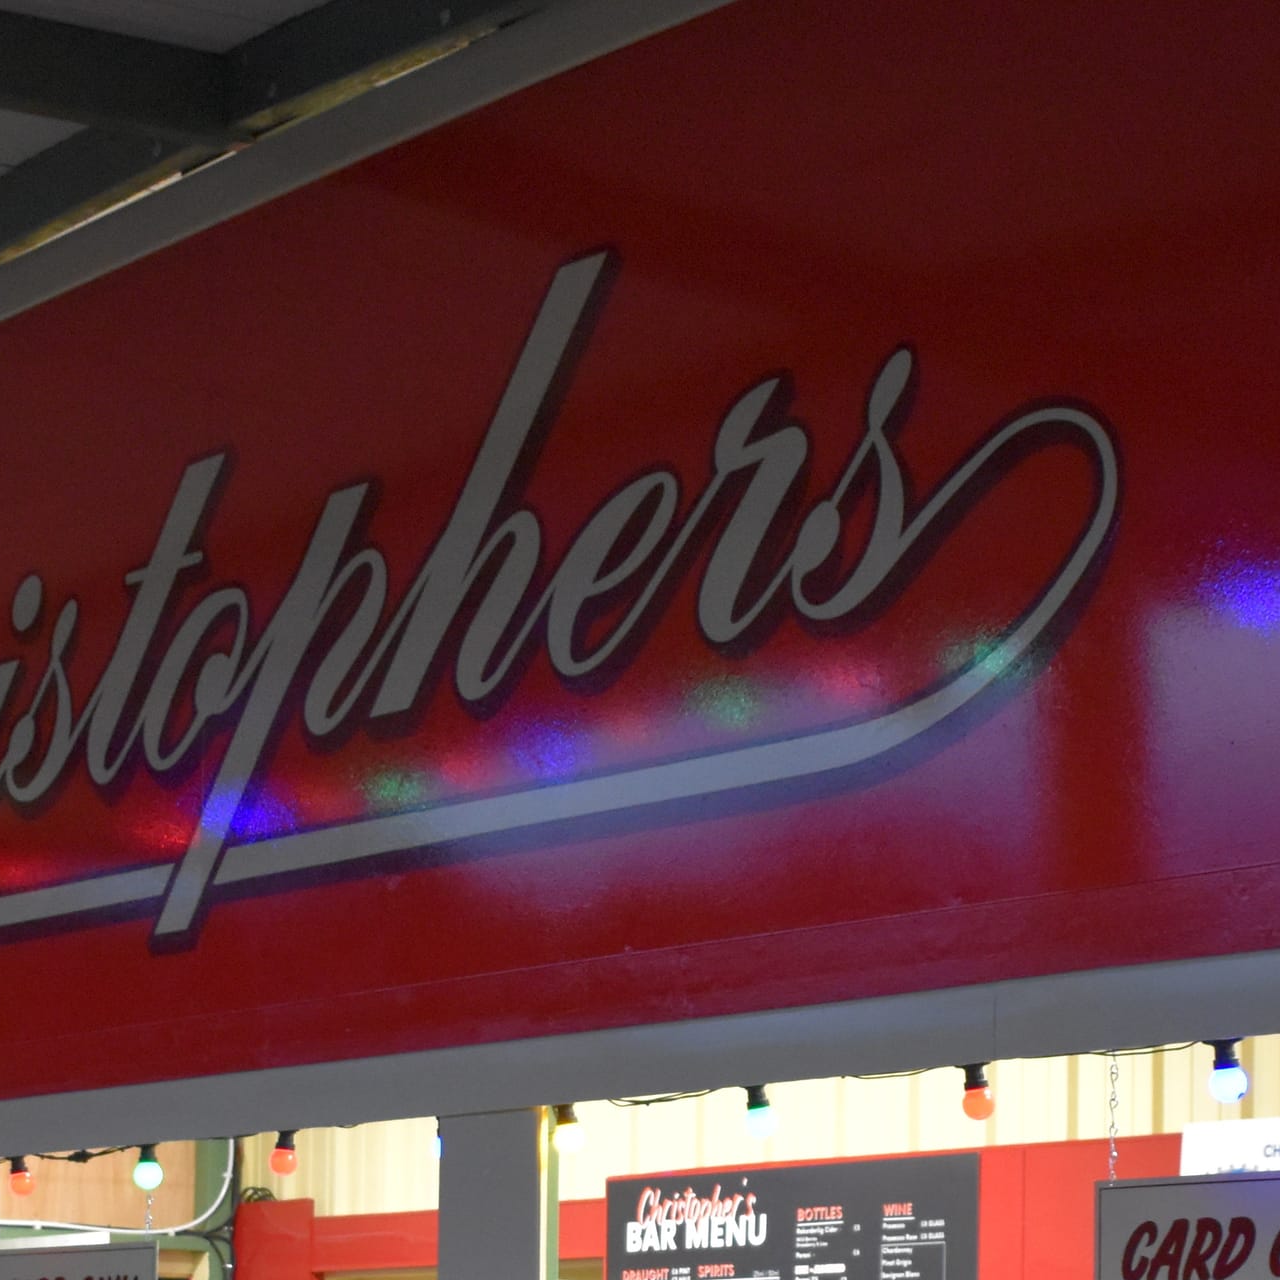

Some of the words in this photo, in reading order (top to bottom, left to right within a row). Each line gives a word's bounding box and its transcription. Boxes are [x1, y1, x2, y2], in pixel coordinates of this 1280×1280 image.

[796, 1205, 843, 1222] BOTTLES
[883, 1202, 913, 1216] WINE
[626, 1221, 677, 1253] BAR
[685, 1213, 768, 1249] MENU
[697, 1264, 735, 1278] SPIRITS
